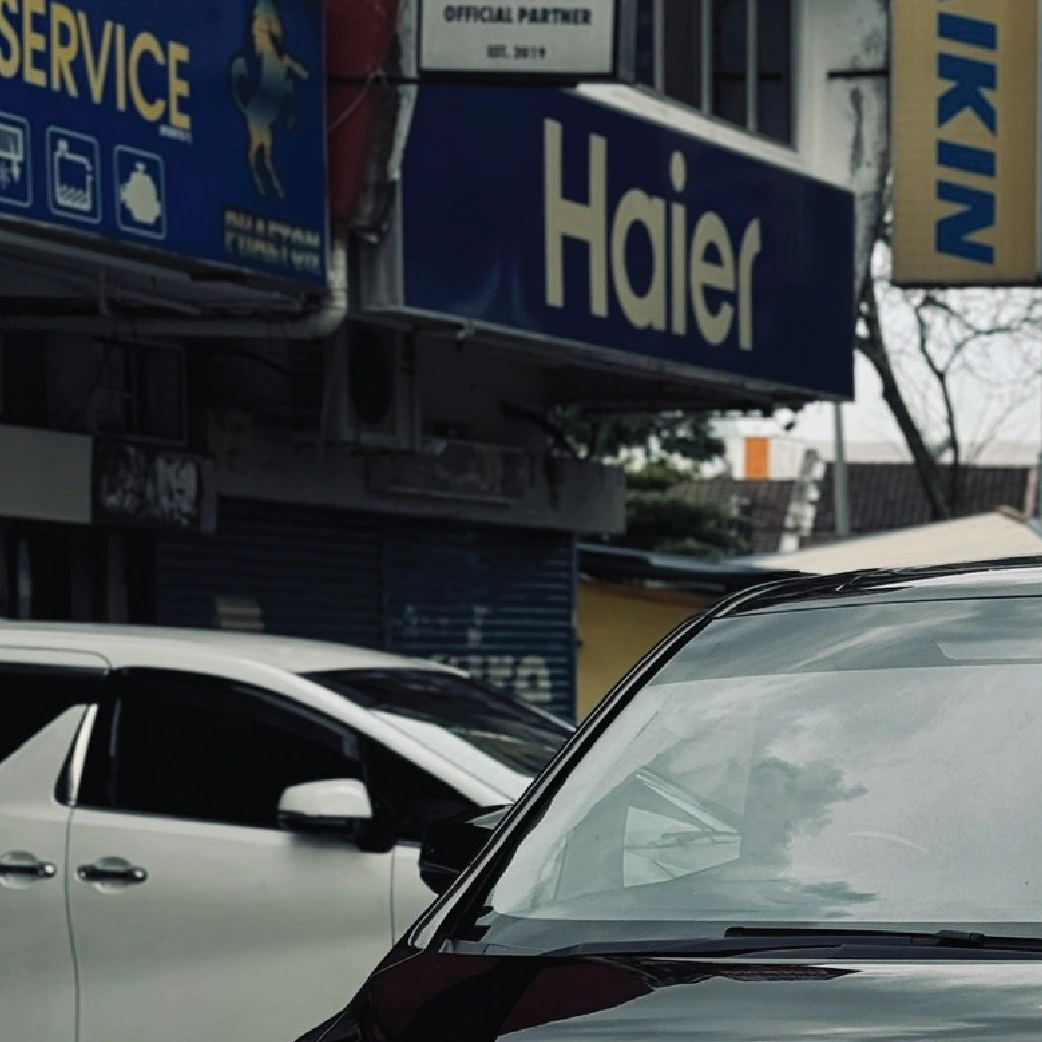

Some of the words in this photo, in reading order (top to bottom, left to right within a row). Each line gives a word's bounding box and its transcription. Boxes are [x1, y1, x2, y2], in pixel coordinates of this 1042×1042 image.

[0, 0, 192, 131] SERVICE
[443, 5, 514, 24] OFFICIAL
[518, 7, 593, 25] PARTNER
[936, 0, 998, 265] IKIN
[543, 118, 762, 351] Haier
